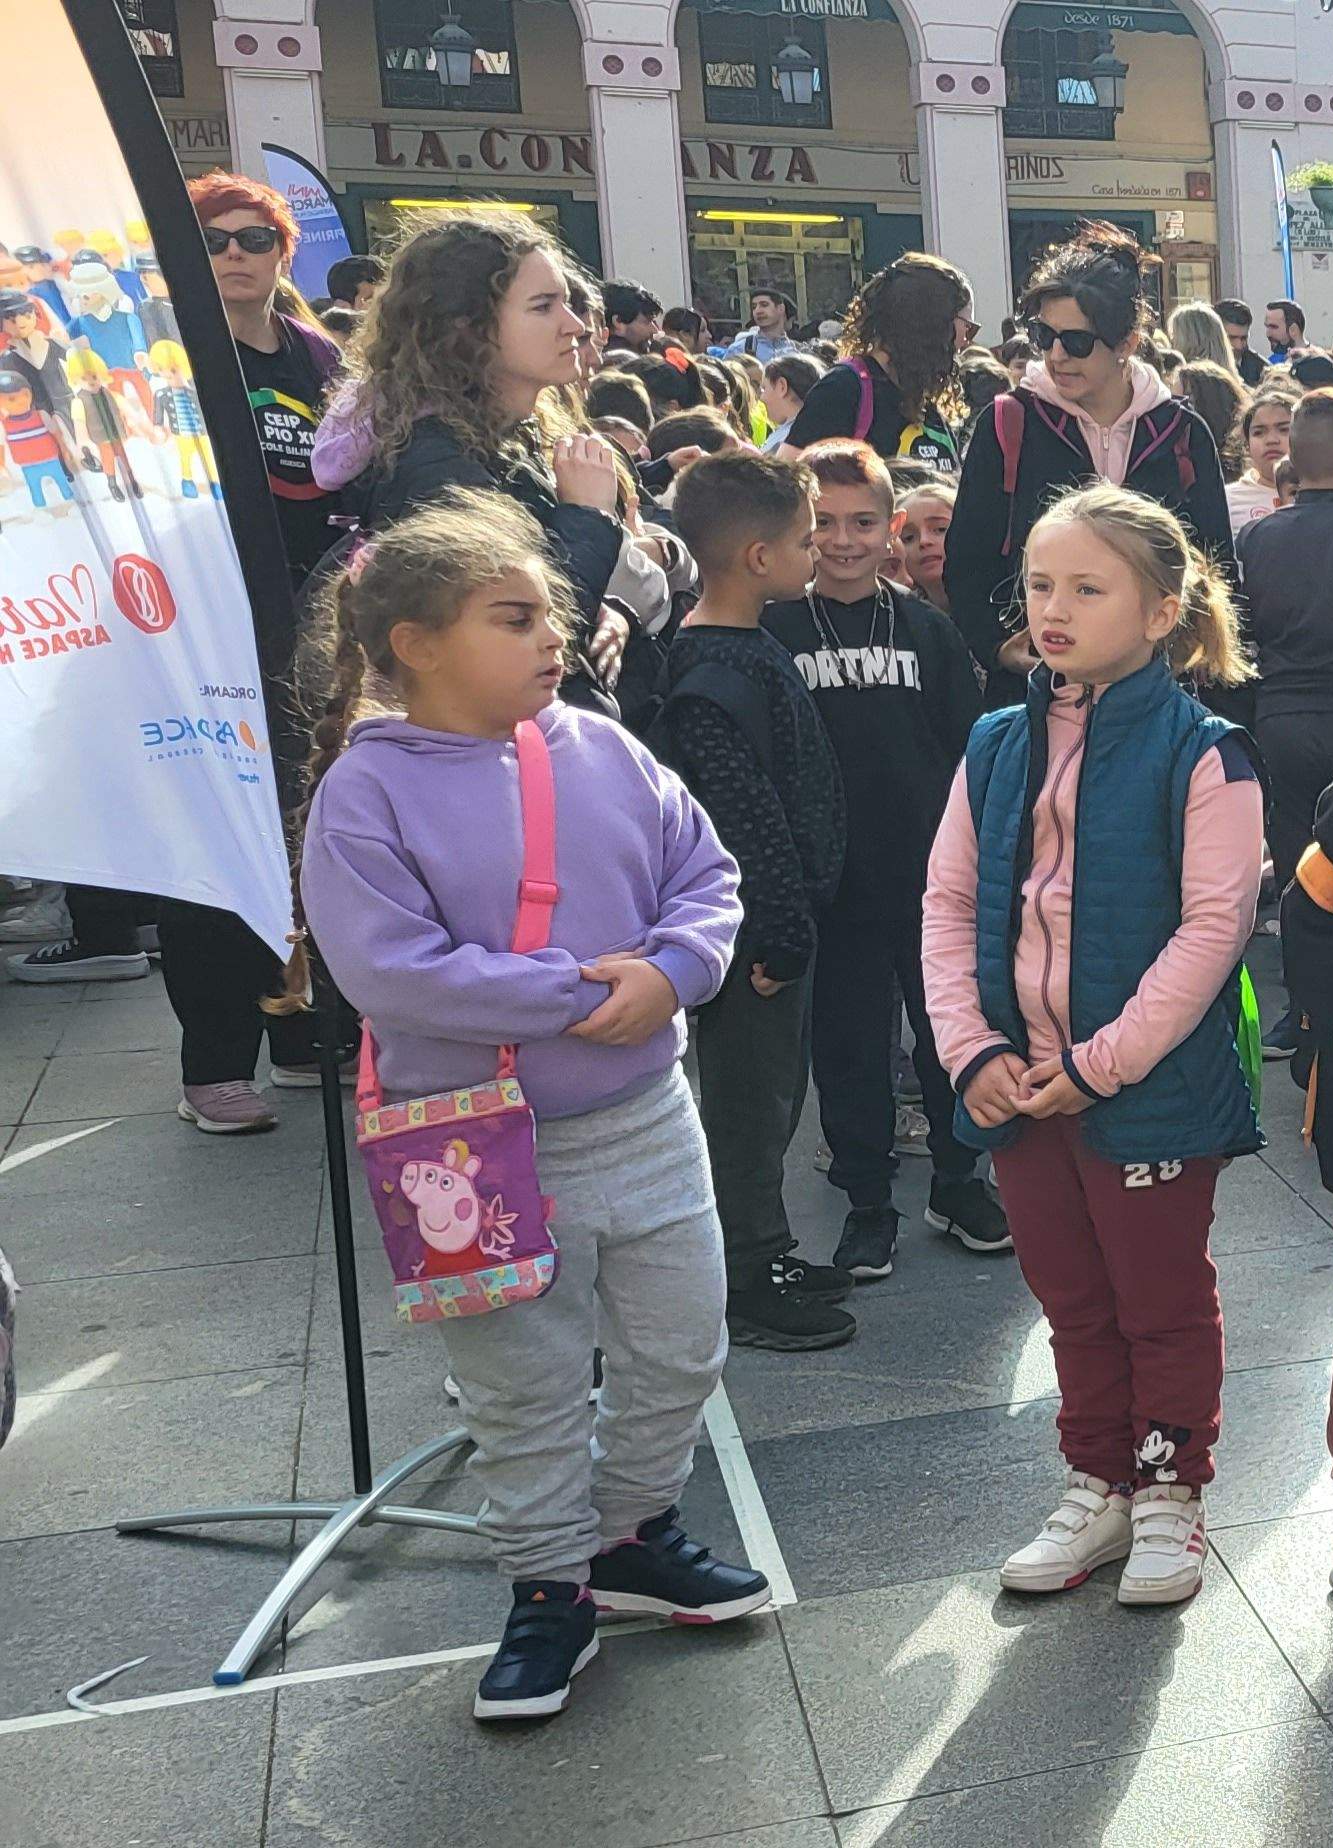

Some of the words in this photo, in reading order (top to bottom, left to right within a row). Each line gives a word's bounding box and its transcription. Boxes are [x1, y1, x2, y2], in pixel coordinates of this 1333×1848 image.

[1064, 10, 1100, 25] desde
[1107, 14, 1134, 27] 1871
[1091, 184, 1114, 196] Casa
[263, 411, 301, 428] CEIP
[263, 425, 293, 443] PIO
[285, 445, 312, 457] BILIN
[918, 445, 939, 459] CEIP
[793, 645, 922, 692] ORTNIT
[1124, 1158, 1183, 1188] 28
